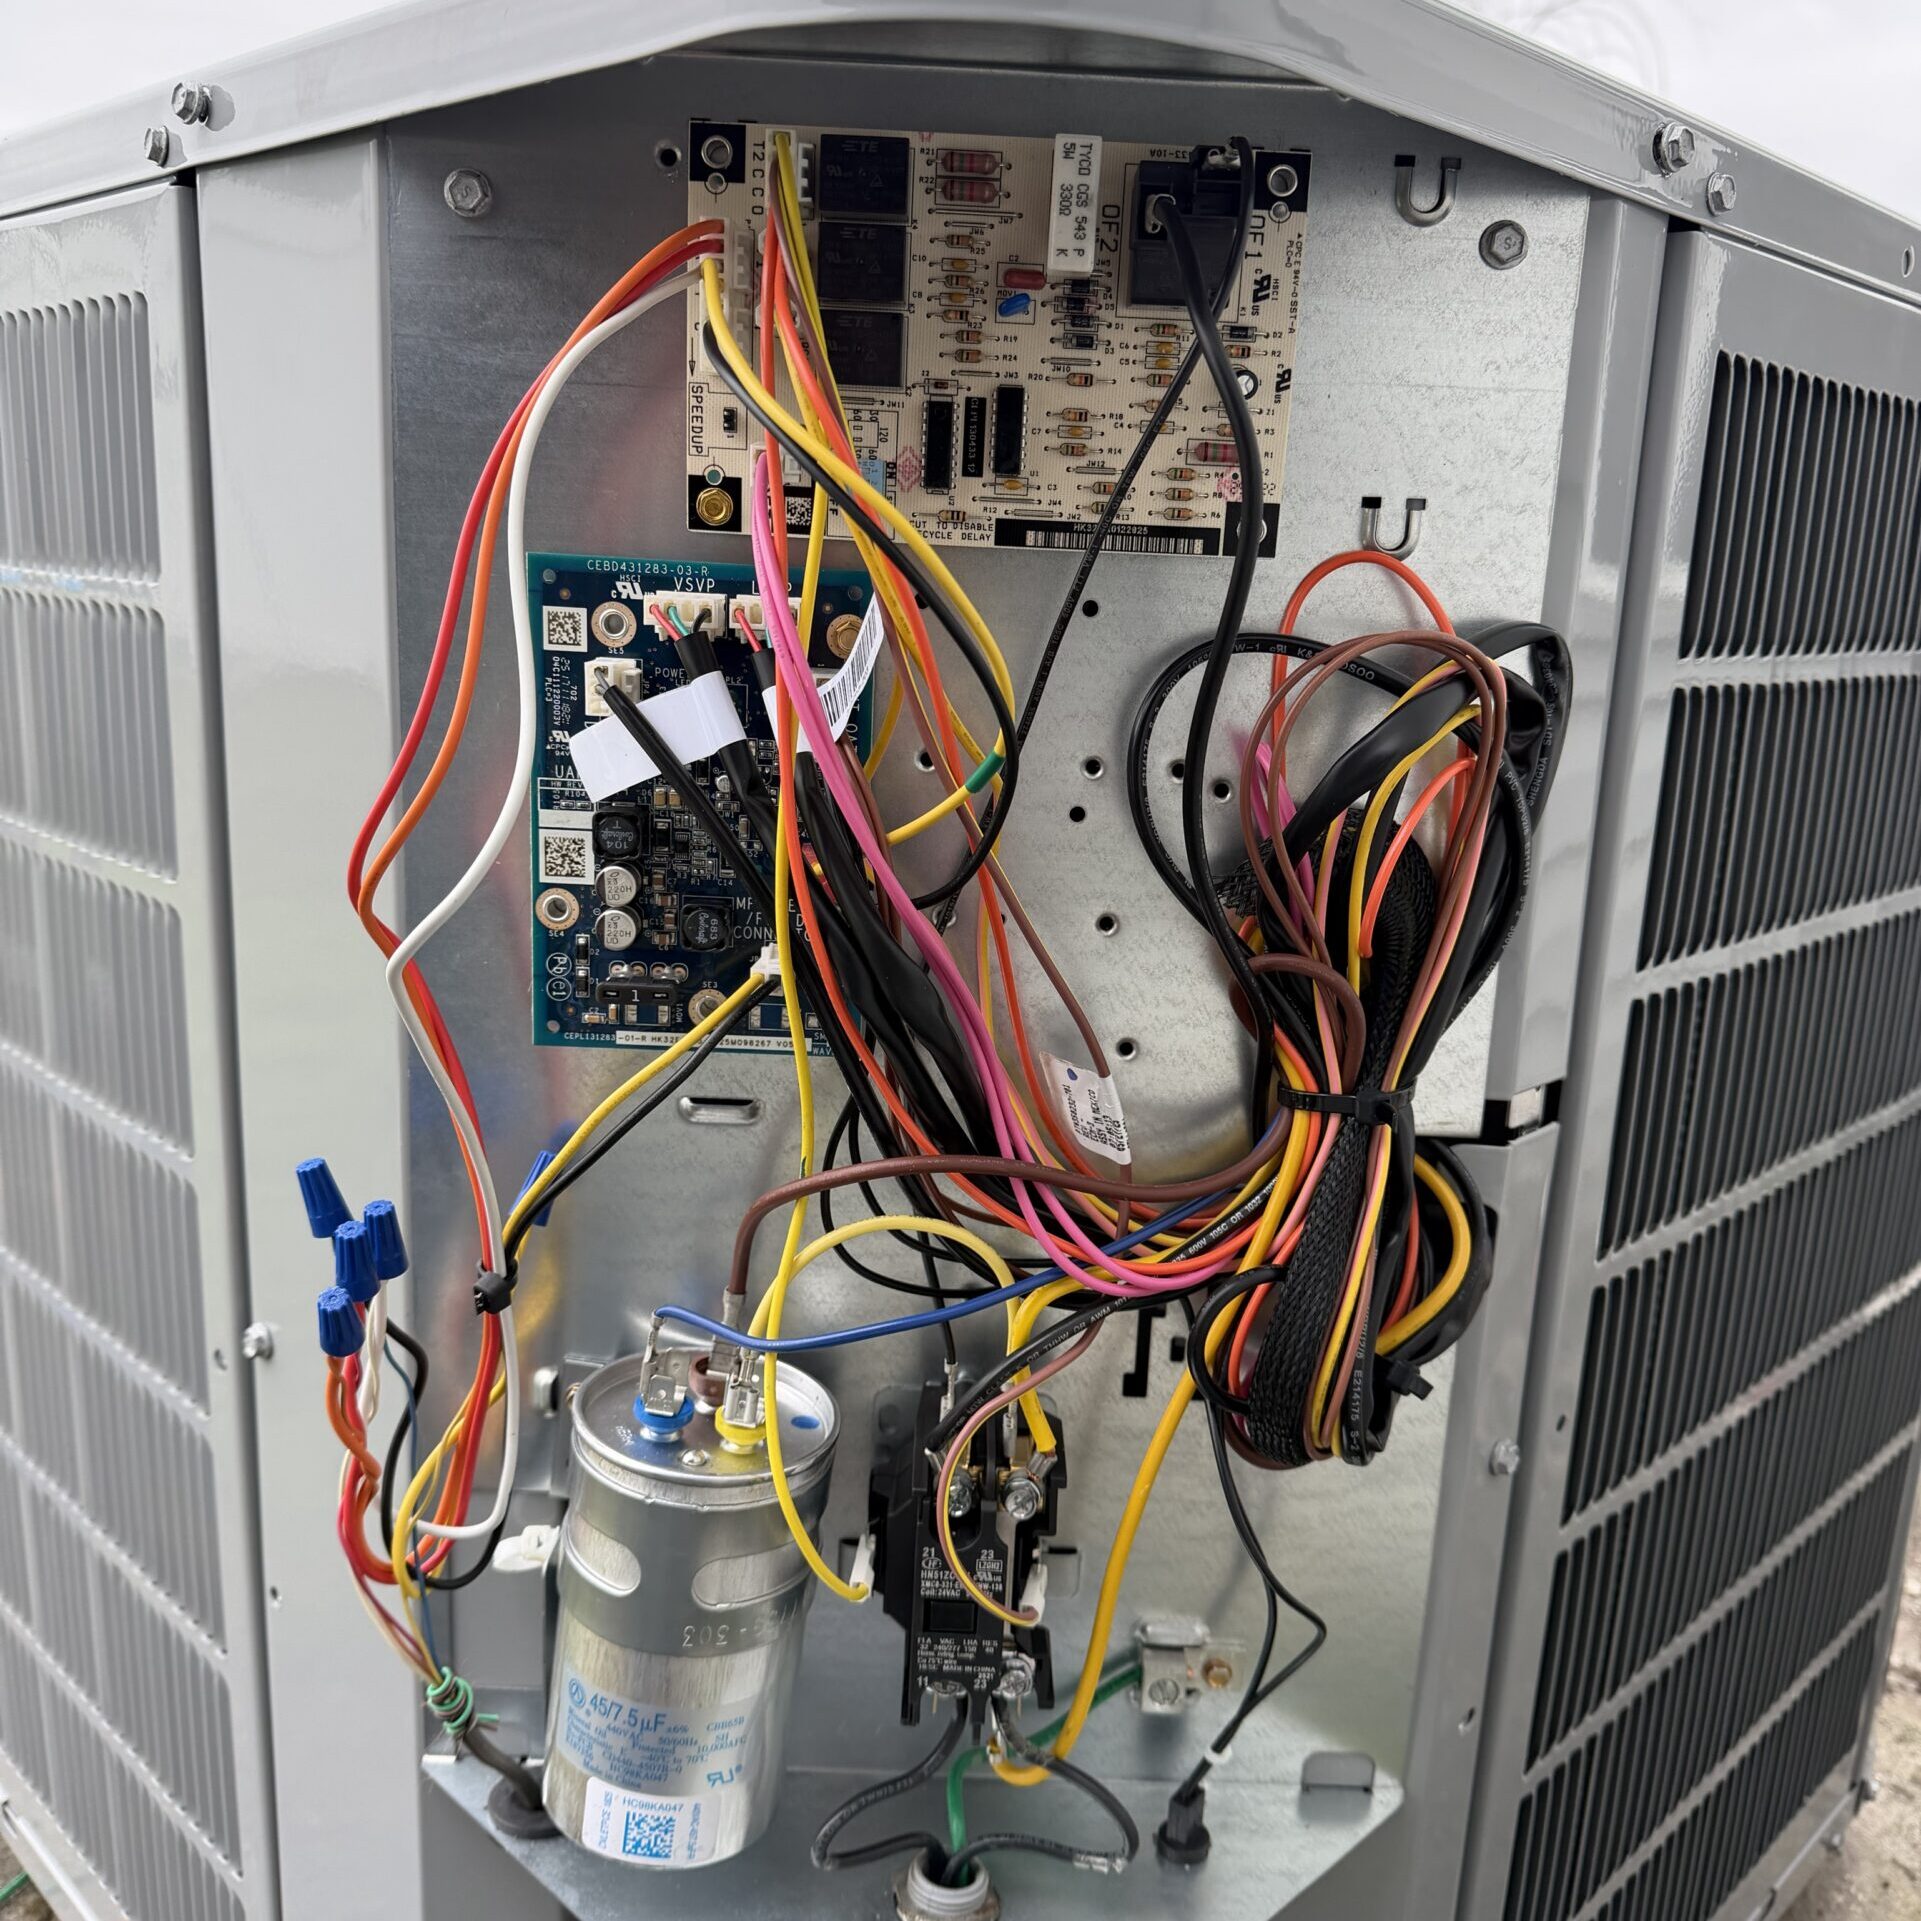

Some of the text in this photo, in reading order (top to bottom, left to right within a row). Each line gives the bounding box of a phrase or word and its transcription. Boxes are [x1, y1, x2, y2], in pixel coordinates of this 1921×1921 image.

[919, 147, 935, 155] R21
[1056, 142, 1076, 257] 5W 330Ω K
[1076, 183, 1090, 208] CGS
[1073, 216, 1088, 241] 543
[1073, 248, 1085, 257] P
[969, 287, 984, 295] R26
[1271, 349, 1281, 357] R2
[691, 385, 704, 454] SPEEDUP
[880, 427, 889, 443] 120
[937, 520, 948, 529] TO
[952, 521, 994, 533] DISABLE
[961, 531, 991, 542] DELAY
[587, 559, 708, 576] CEBD431283-03-R
[674, 577, 715, 592] VSVP
[655, 667, 686, 678] POWE
[570, 685, 578, 701] 702
[1505, 771, 1518, 791] PVC
[606, 841, 628, 849] 104
[607, 885, 632, 893] 220H
[607, 930, 632, 938] 220H
[710, 919, 718, 940] 683
[631, 989, 640, 1002] 1
[1087, 1089, 1100, 1114] MEXICO
[1188, 1196, 1262, 1255] 600V 105C OR 1032
[1089, 1306, 1111, 1323] AWM
[1350, 1370, 1363, 1421] E214175
[922, 1547, 994, 1559] 21 23
[973, 1666, 996, 1674] CHINA
[917, 1676, 987, 1689] 11 23
